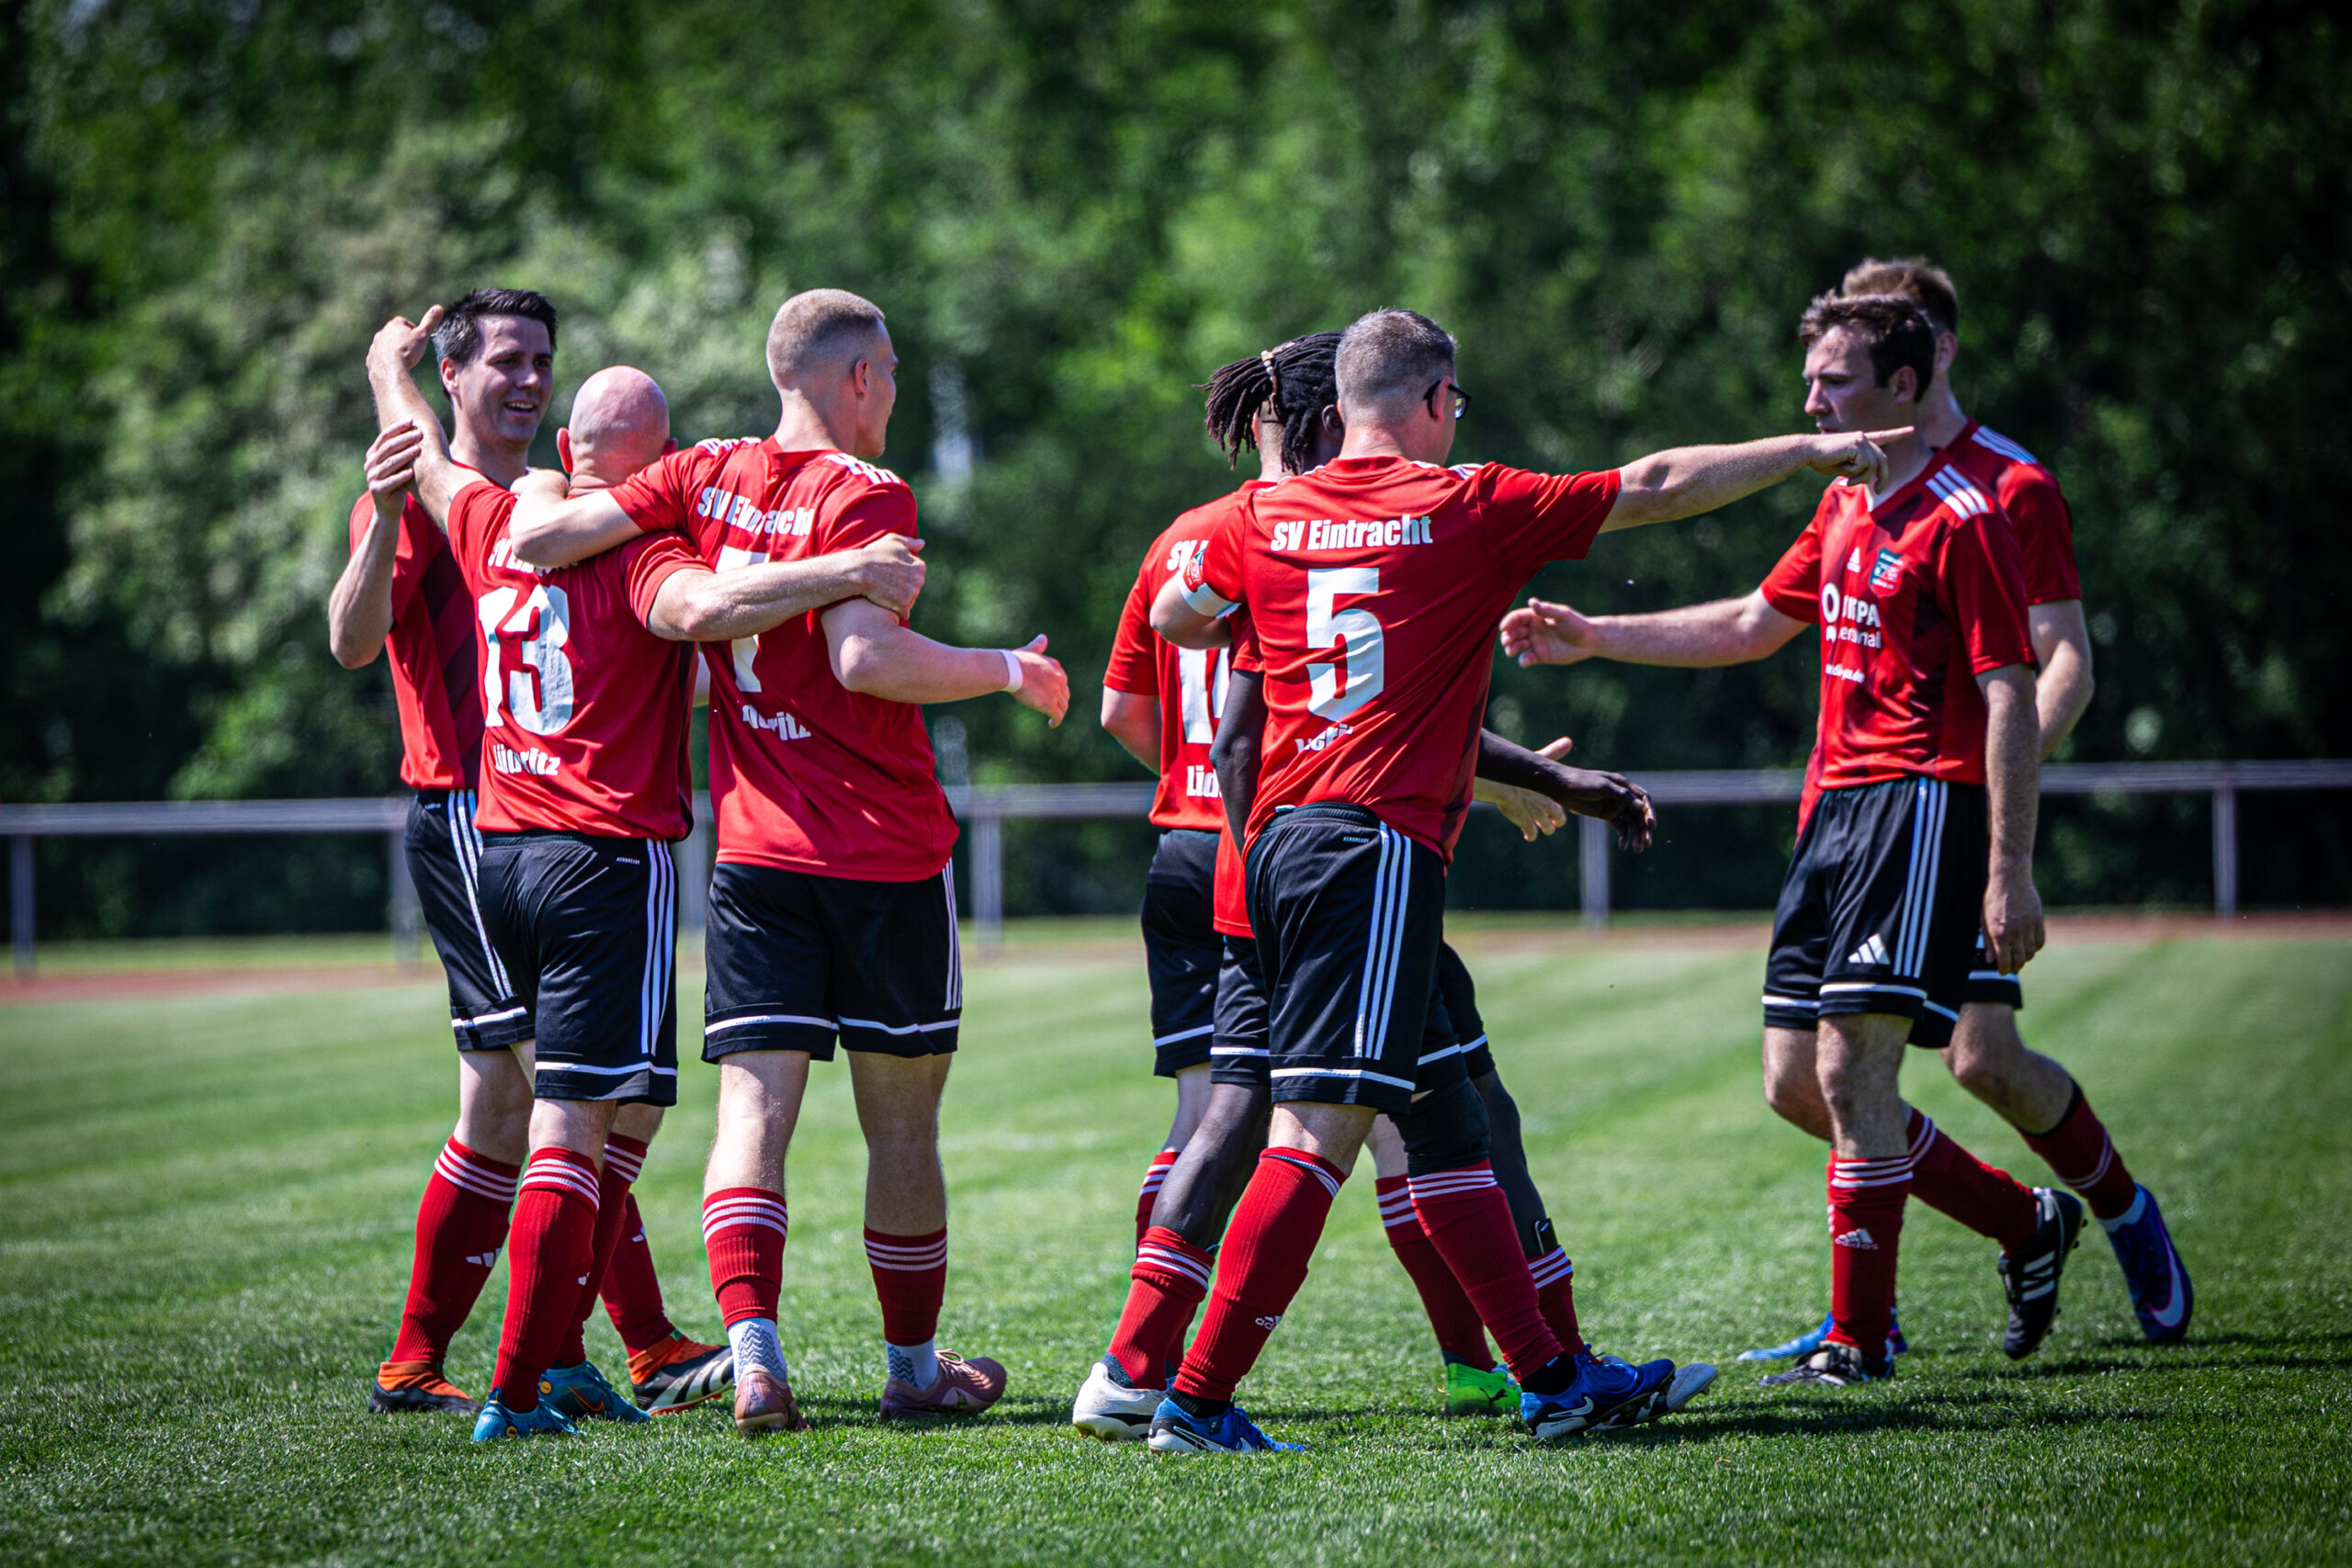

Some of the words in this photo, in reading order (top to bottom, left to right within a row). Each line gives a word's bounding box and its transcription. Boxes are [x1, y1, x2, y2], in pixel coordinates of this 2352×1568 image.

[697, 486, 732, 520] SV
[1271, 518, 1306, 551] SV
[1306, 514, 1433, 550] Eintracht
[478, 581, 574, 736] 13
[1306, 567, 1385, 722] 5
